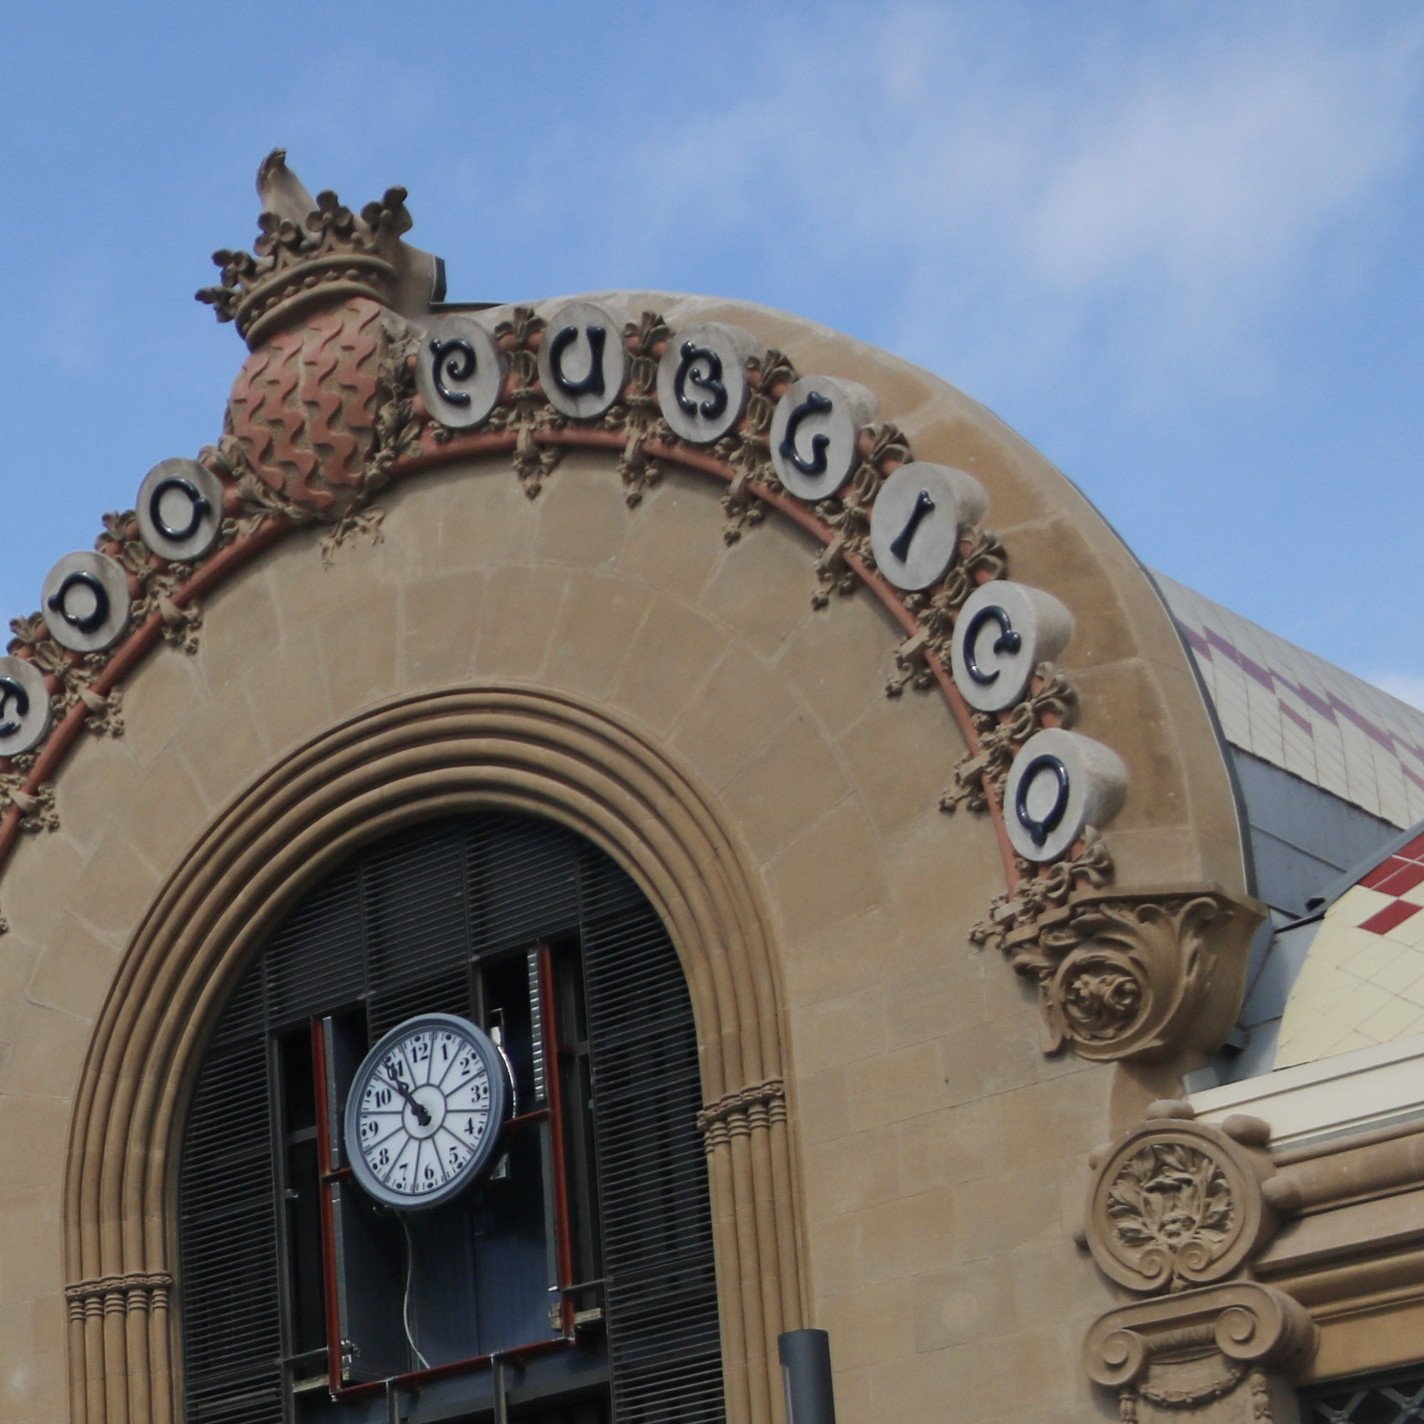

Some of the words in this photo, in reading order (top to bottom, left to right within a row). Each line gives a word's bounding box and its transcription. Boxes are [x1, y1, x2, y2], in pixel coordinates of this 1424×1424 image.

[410, 1043, 428, 1063] 12
[441, 1044, 448, 1061] 1
[460, 1057, 470, 1076] 2
[375, 1088, 391, 1108] 10
[471, 1085, 481, 1103] 3
[369, 1121, 378, 1137] 9
[464, 1117, 474, 1135] 4
[379, 1148, 389, 1166] 8
[449, 1147, 459, 1164] 5
[399, 1163, 408, 1181] 7
[424, 1165, 434, 1180] 6
